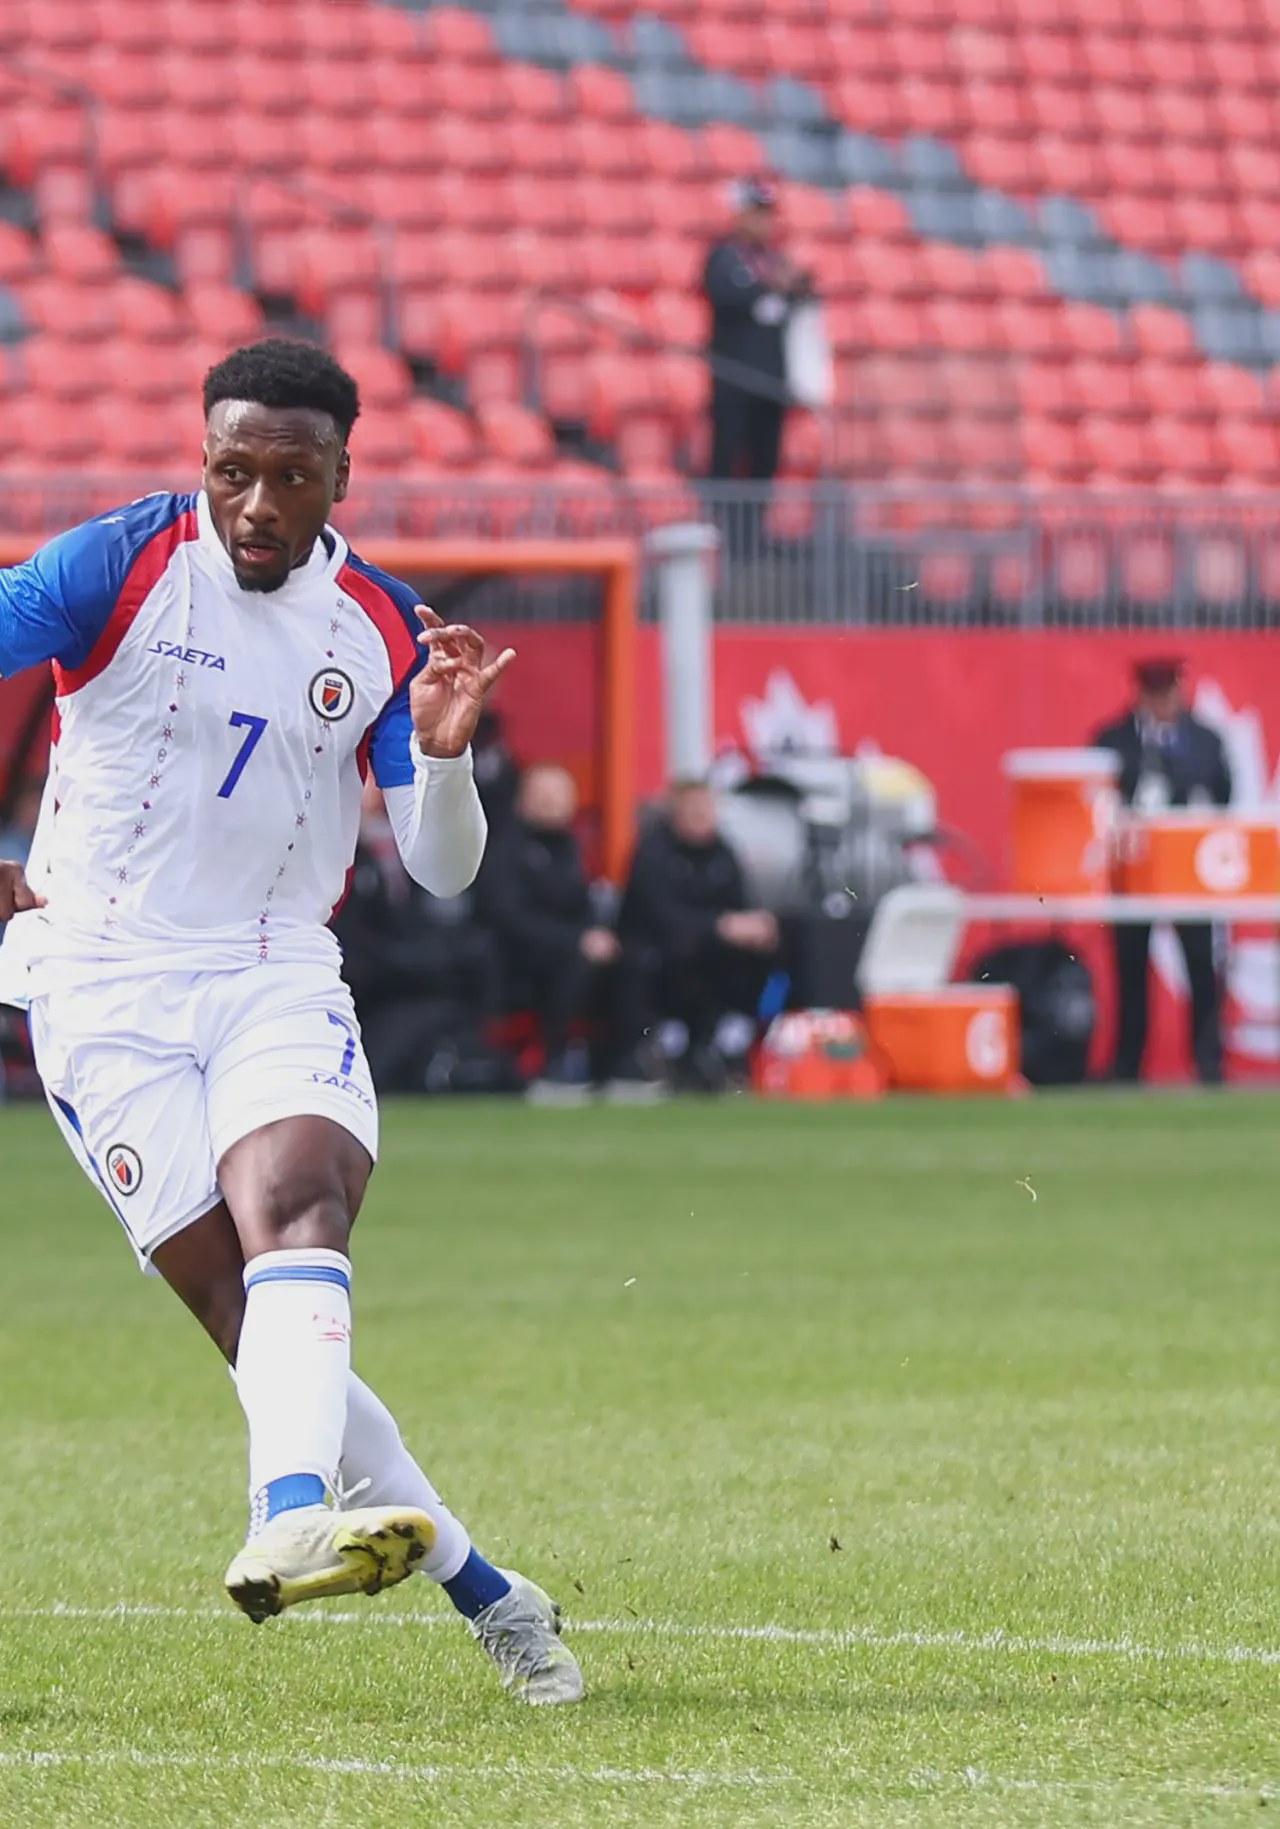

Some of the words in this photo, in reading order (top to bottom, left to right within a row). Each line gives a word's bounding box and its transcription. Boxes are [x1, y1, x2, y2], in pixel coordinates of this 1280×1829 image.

[147, 640, 226, 671] SAETA
[217, 711, 268, 799] 7
[327, 1010, 355, 1076] 7
